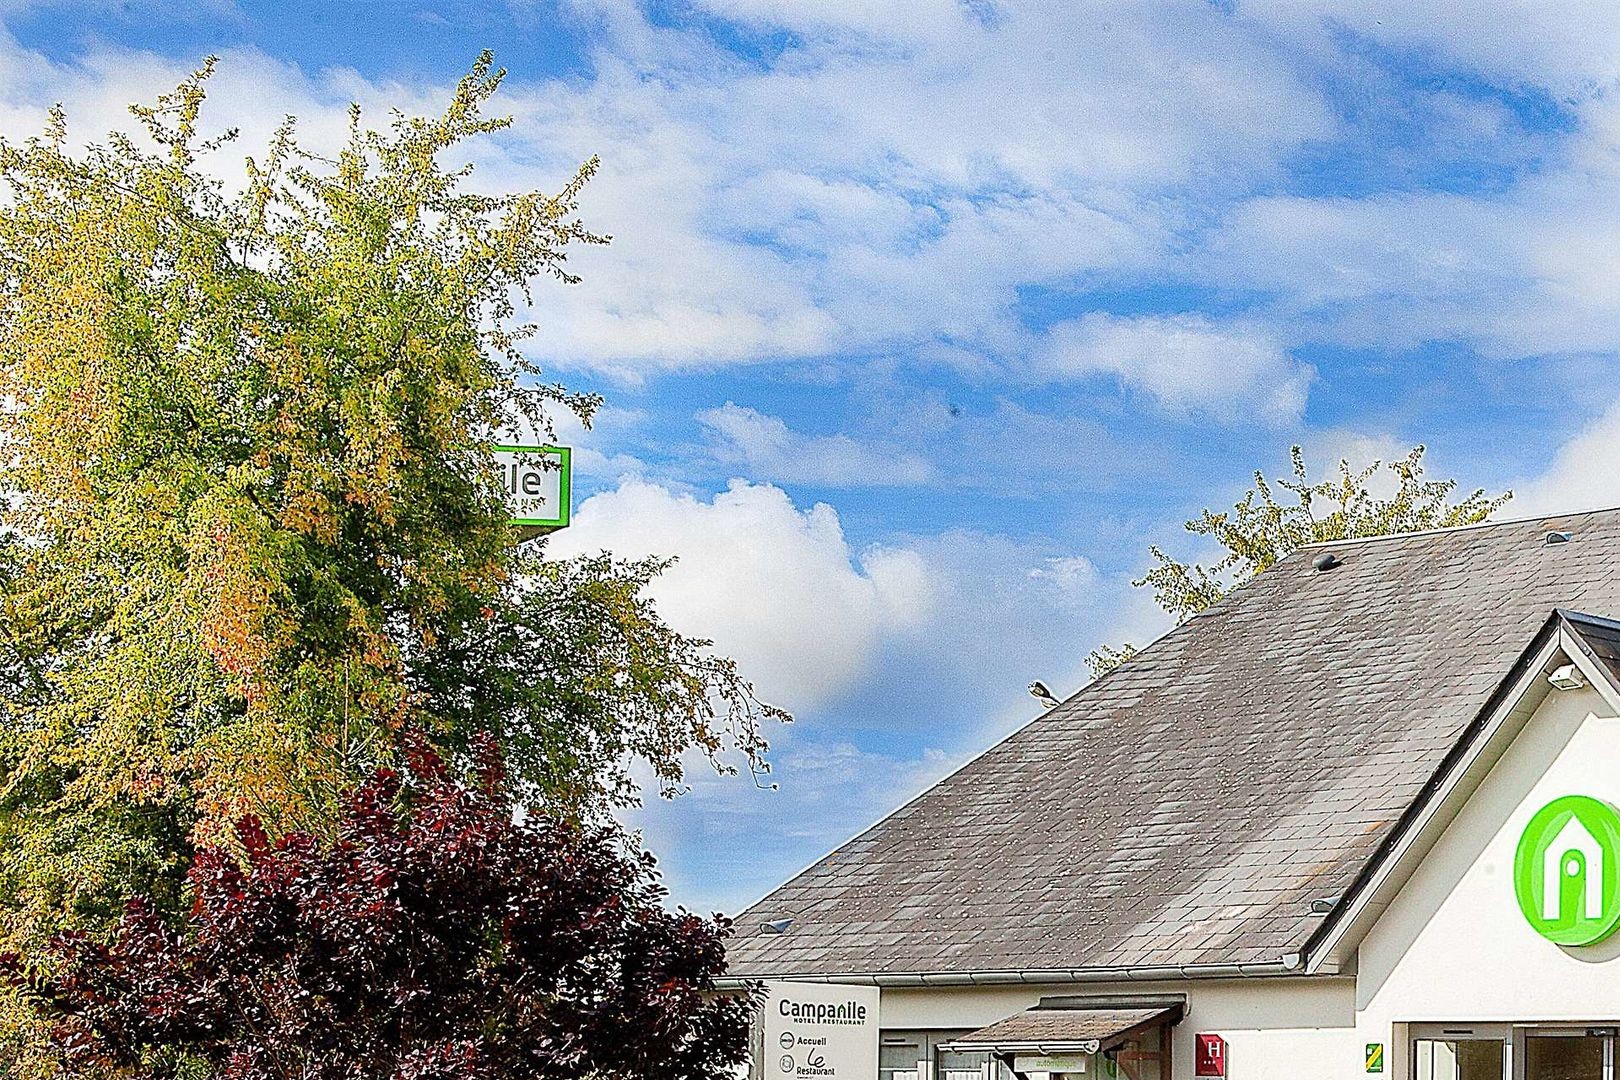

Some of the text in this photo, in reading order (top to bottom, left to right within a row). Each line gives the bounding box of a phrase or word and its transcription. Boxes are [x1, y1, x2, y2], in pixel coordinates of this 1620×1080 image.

[779, 999, 866, 1024] Campanile
[797, 1037, 827, 1045] Accueil
[1208, 1041, 1221, 1058] H
[796, 1066, 835, 1076] Restaurant
